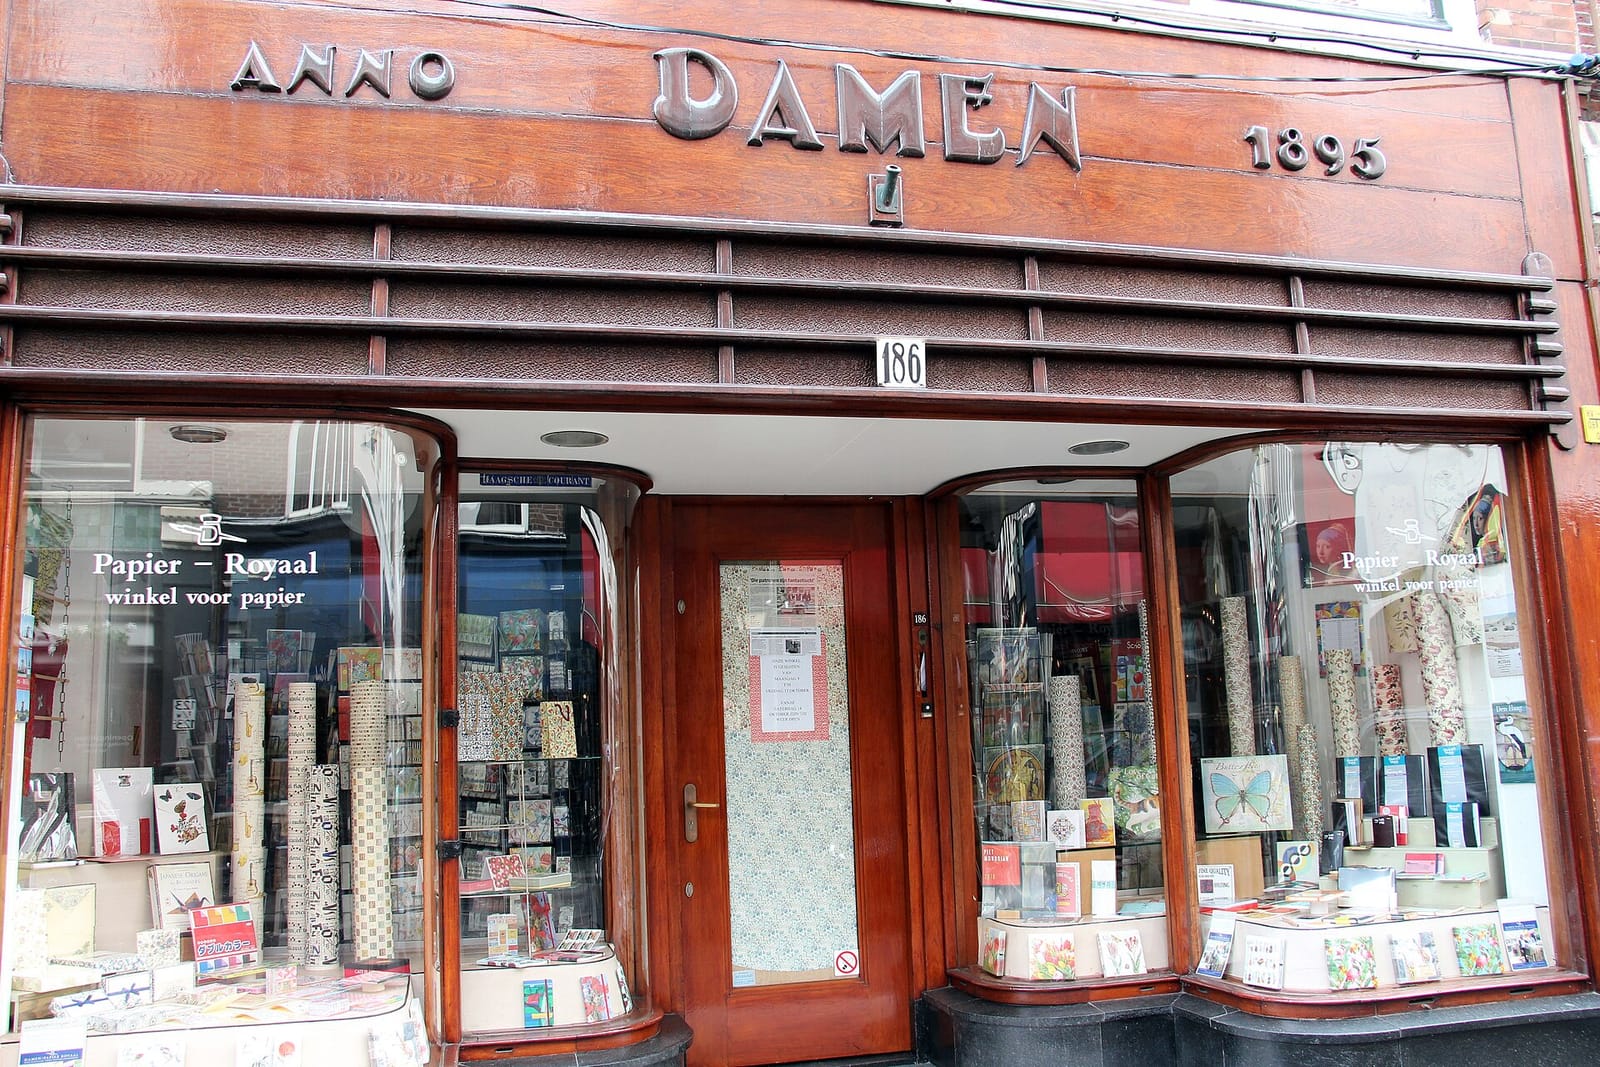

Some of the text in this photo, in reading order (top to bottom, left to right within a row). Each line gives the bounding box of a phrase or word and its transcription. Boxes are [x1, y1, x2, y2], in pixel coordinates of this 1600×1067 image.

[230, 39, 456, 101] ANNO
[651, 46, 1083, 172] DAMEN
[1243, 124, 1388, 180] 1895
[882, 342, 921, 384] 186
[482, 473, 590, 485] HAAGSCHE COURANT
[93, 552, 182, 582] Papier
[224, 550, 319, 581] Royaal
[1341, 550, 1399, 575] Papier
[1425, 547, 1484, 572] Royaal
[105, 586, 306, 610] winkel voor papier
[1354, 577, 1480, 594] winkel voor papier
[915, 614, 927, 624] 186
